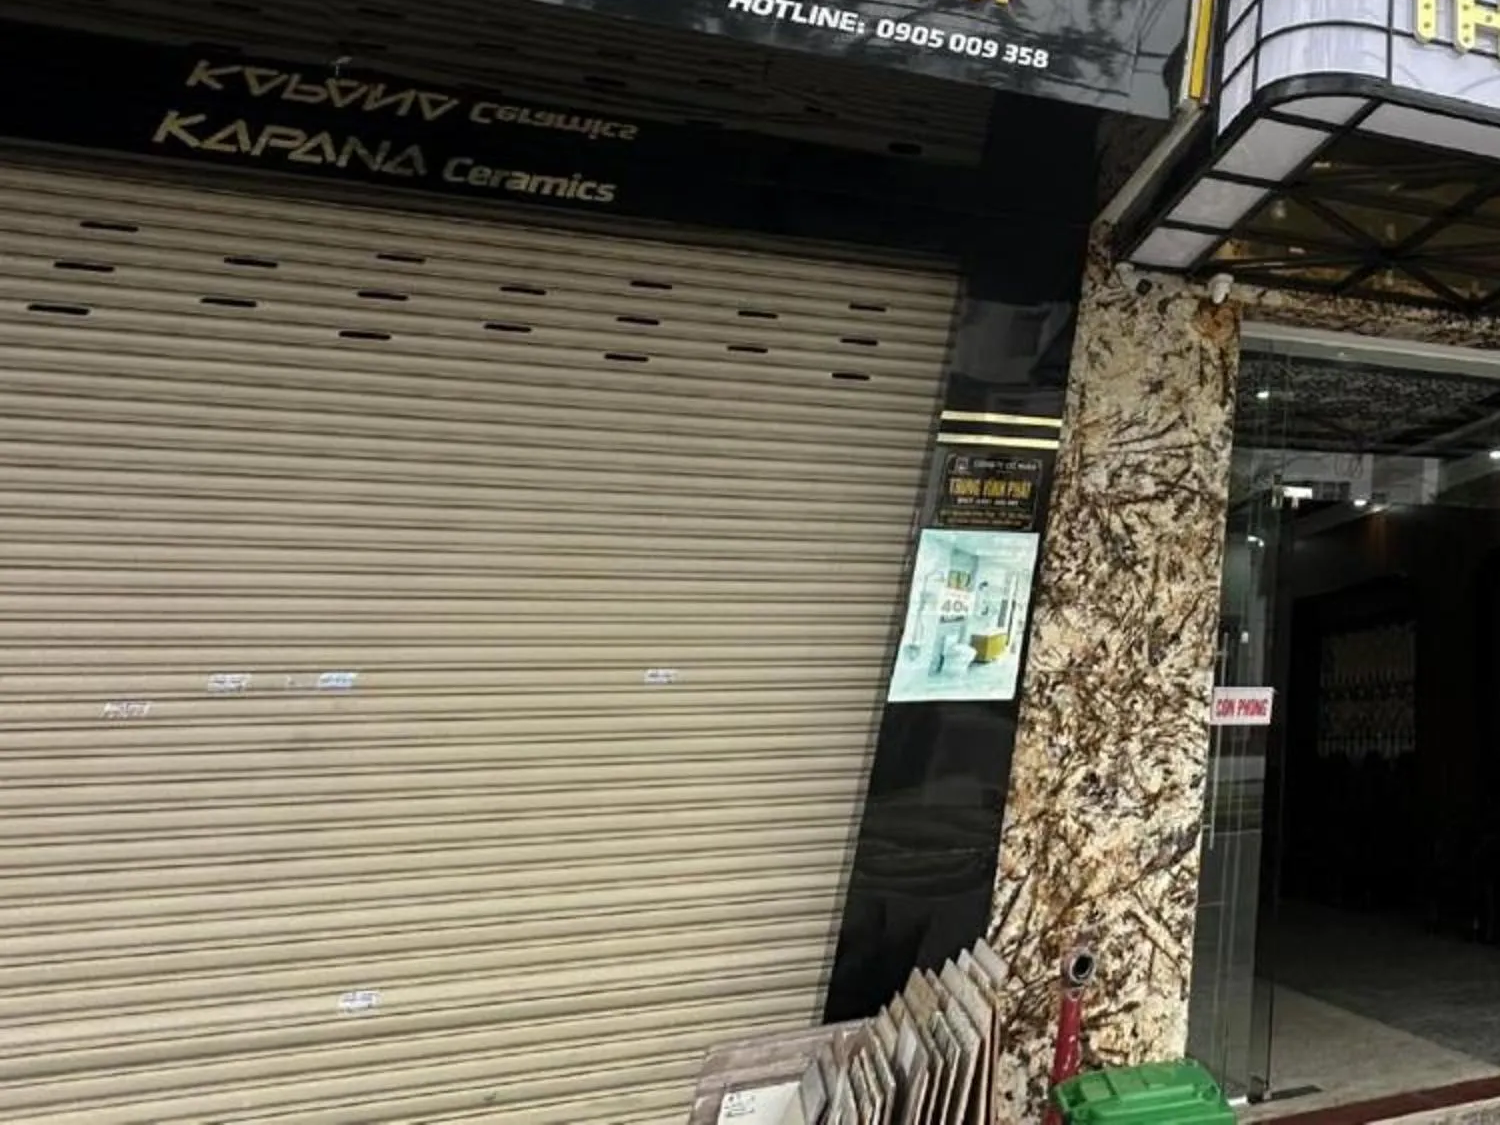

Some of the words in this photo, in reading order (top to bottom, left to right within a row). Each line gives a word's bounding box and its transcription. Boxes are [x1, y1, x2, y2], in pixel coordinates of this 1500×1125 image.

[876, 18, 944, 54] 0905
[949, 30, 999, 60] 009
[1003, 41, 1049, 70] 358
[151, 107, 428, 177] KAPANA
[443, 156, 618, 204] Ceramics
